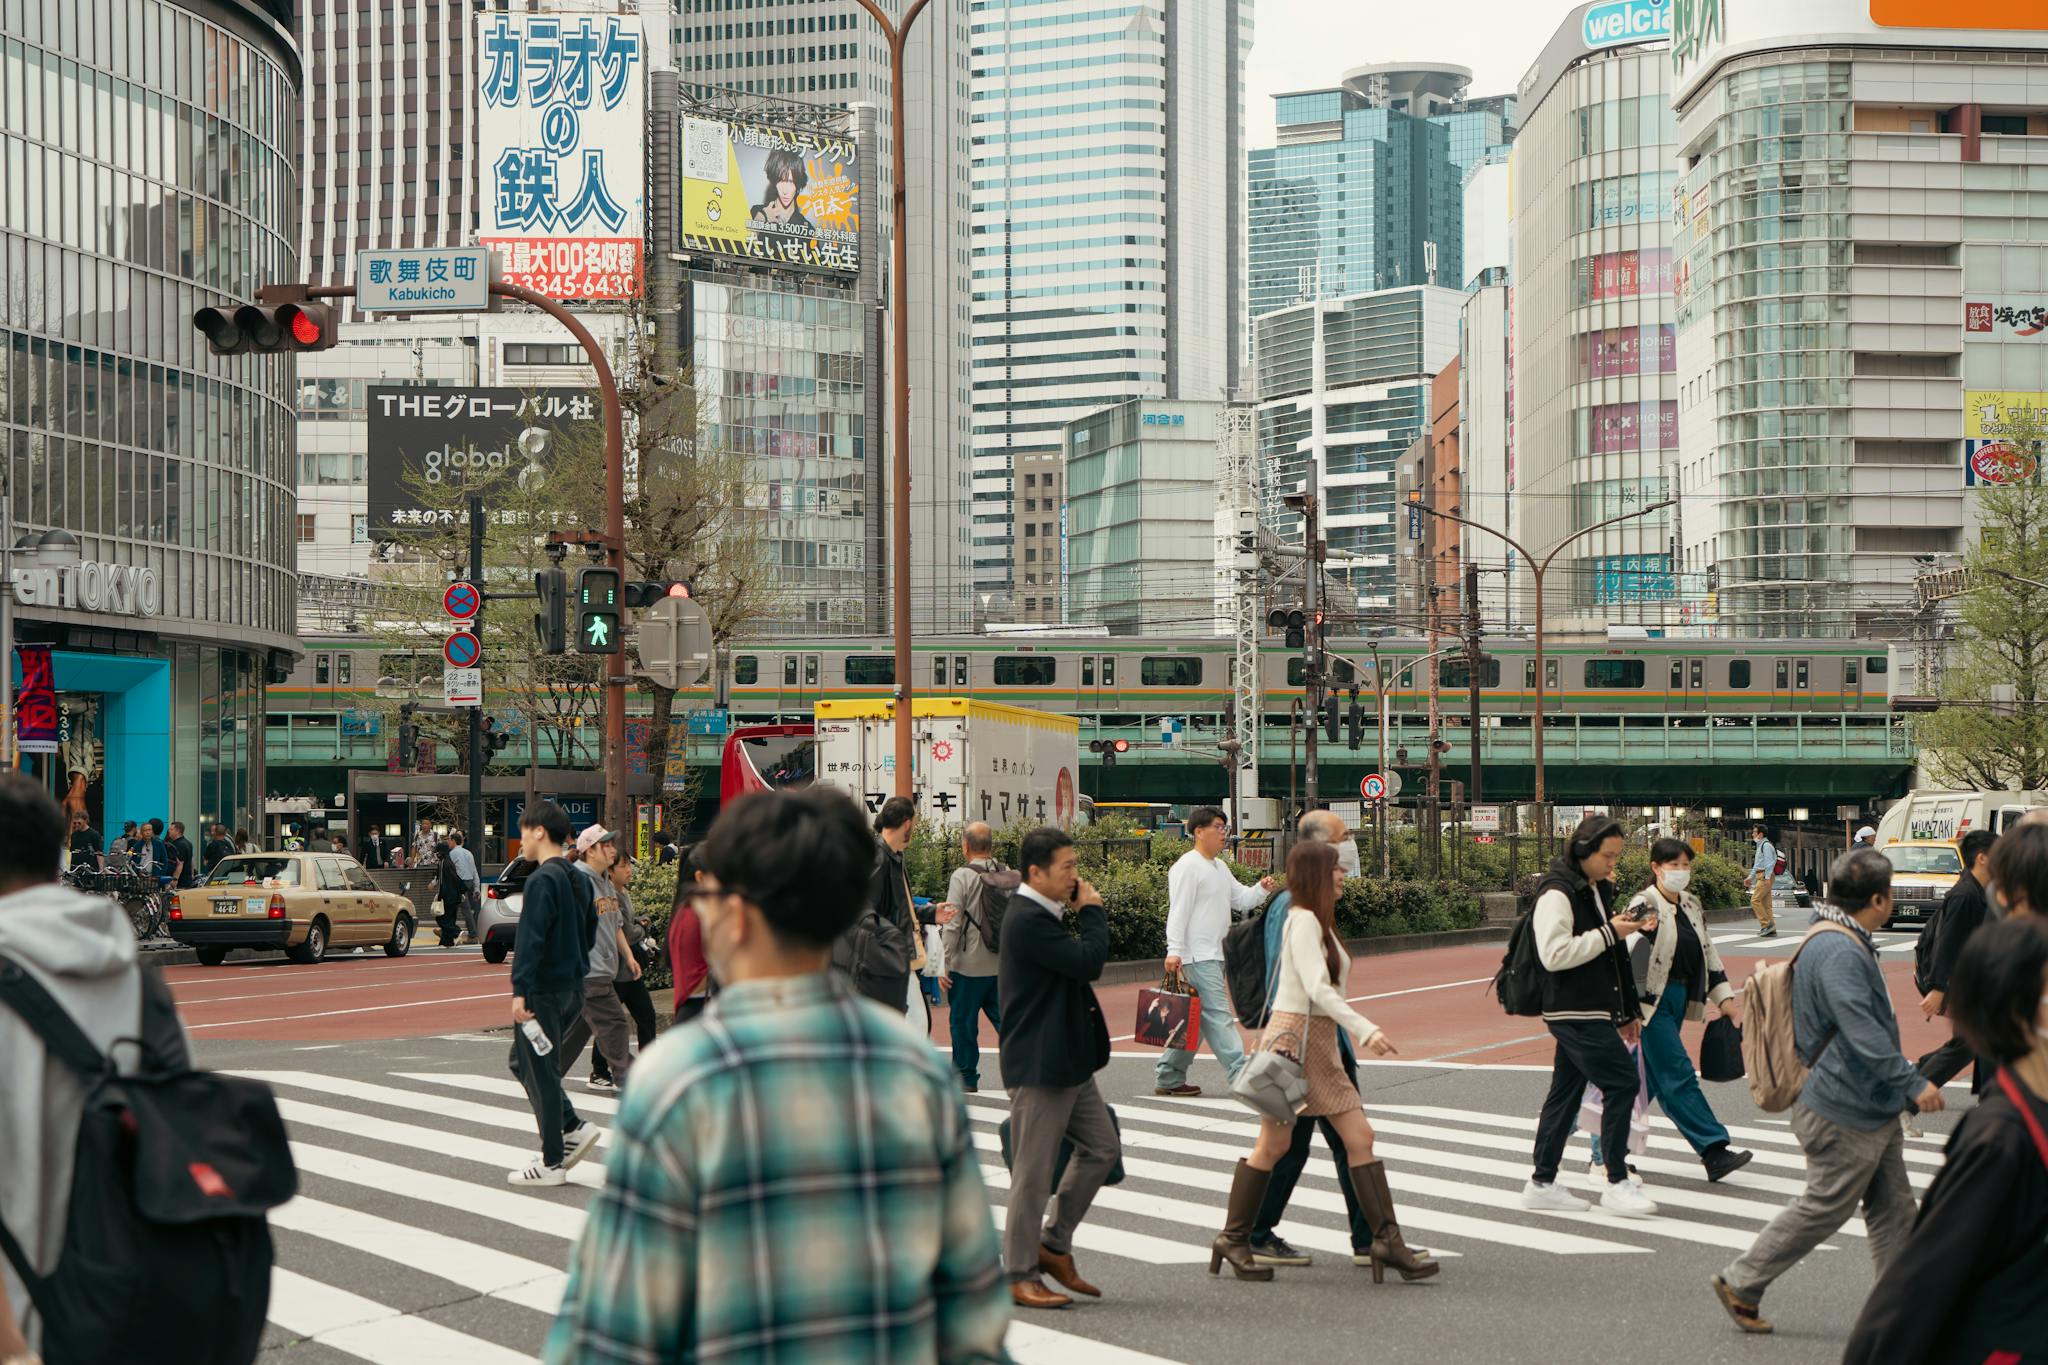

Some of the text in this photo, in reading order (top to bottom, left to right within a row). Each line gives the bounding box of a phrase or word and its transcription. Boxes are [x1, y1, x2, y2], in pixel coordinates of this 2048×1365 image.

[481, 15, 639, 112] カラオケ
[541, 100, 580, 158] の
[493, 147, 628, 234] 鉄人
[369, 256, 477, 284] 歌舞伎町
[745, 235, 859, 271] たいせい先生
[389, 286, 455, 301] Kabukicho
[377, 394, 594, 420] THEグローバル社
[58, 560, 158, 617] TOKYO
